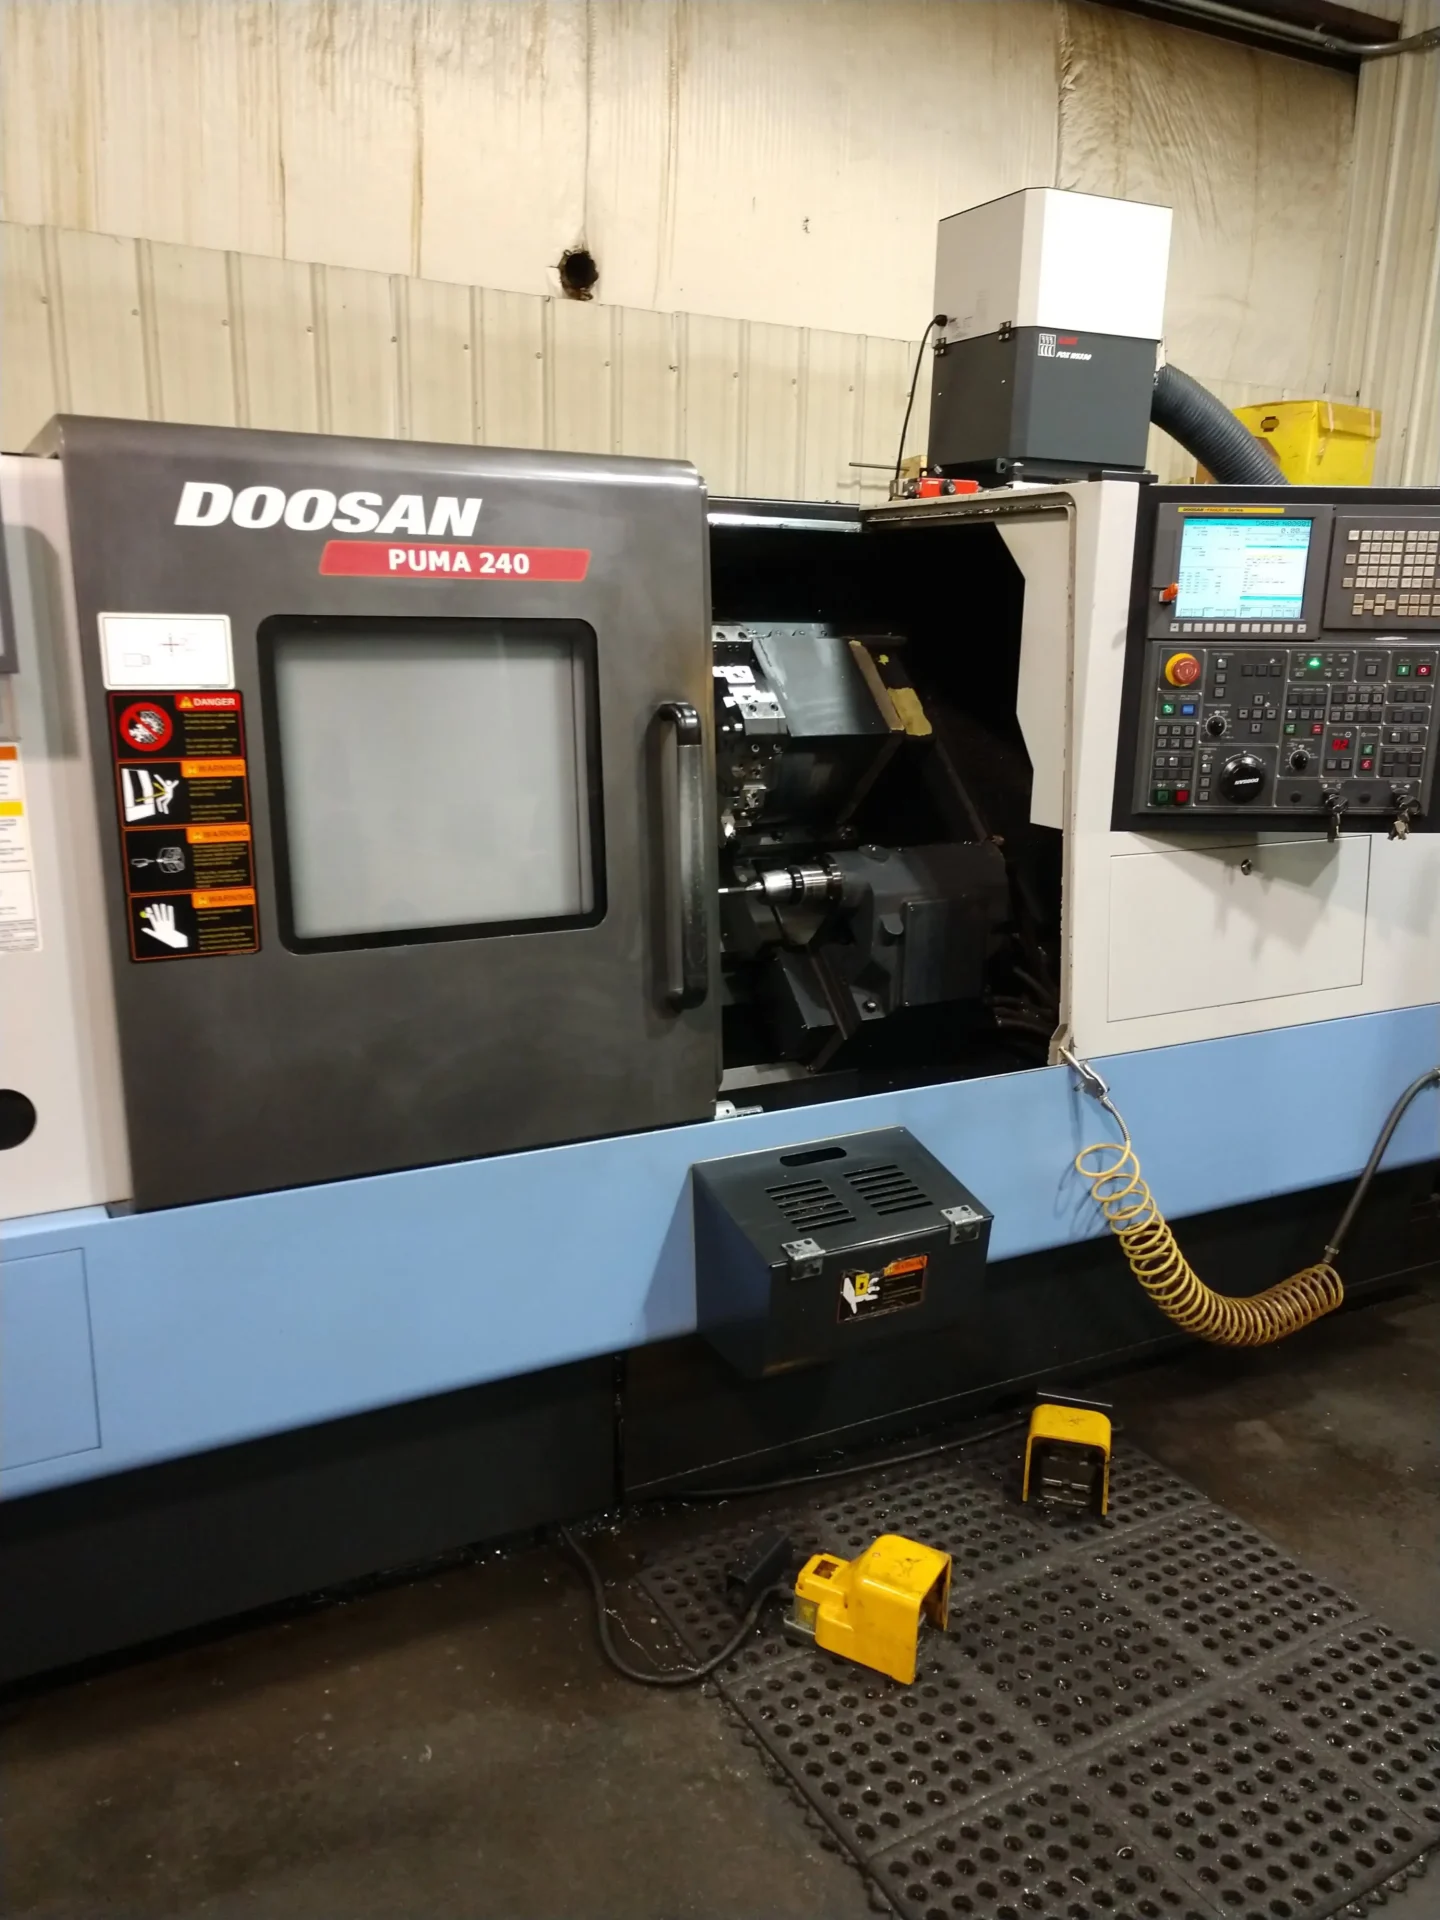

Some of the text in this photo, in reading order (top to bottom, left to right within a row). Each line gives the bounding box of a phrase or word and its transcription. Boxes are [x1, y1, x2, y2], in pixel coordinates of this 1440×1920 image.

[174, 481, 483, 537] DOOSAN
[388, 549, 530, 574] PUMA 240
[193, 697, 236, 706] DANGER
